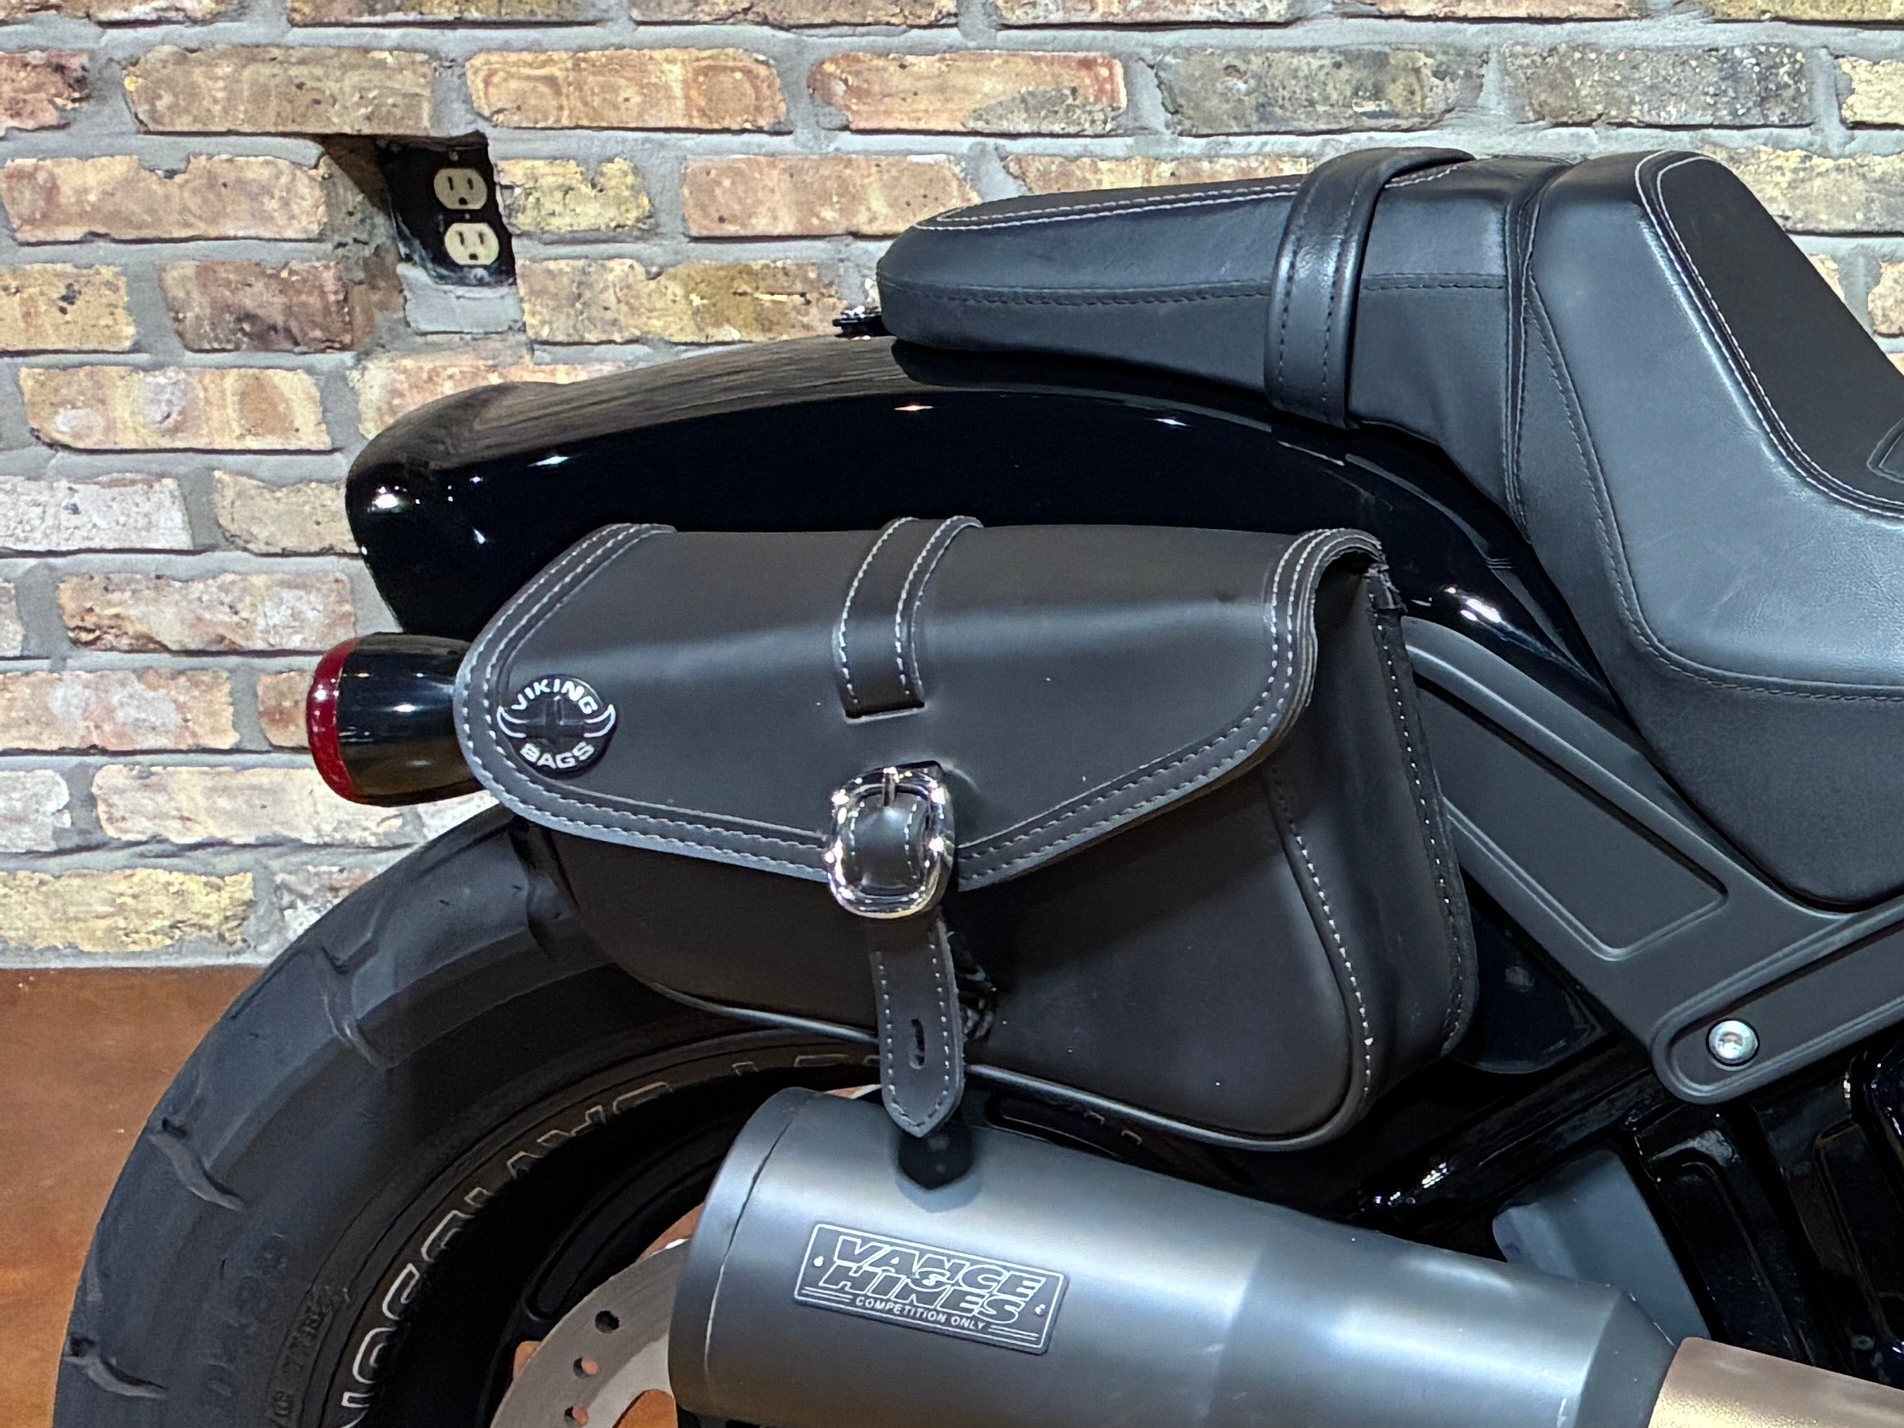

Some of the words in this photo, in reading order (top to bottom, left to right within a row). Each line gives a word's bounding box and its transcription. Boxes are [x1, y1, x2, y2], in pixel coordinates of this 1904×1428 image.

[511, 679, 598, 714] VIKING
[520, 741, 594, 769] BAGS
[834, 1236, 1046, 1301] VANCE
[819, 1262, 1025, 1324] HINES
[855, 1296, 947, 1324] COMPETITION
[951, 1314, 986, 1330] ONLY
